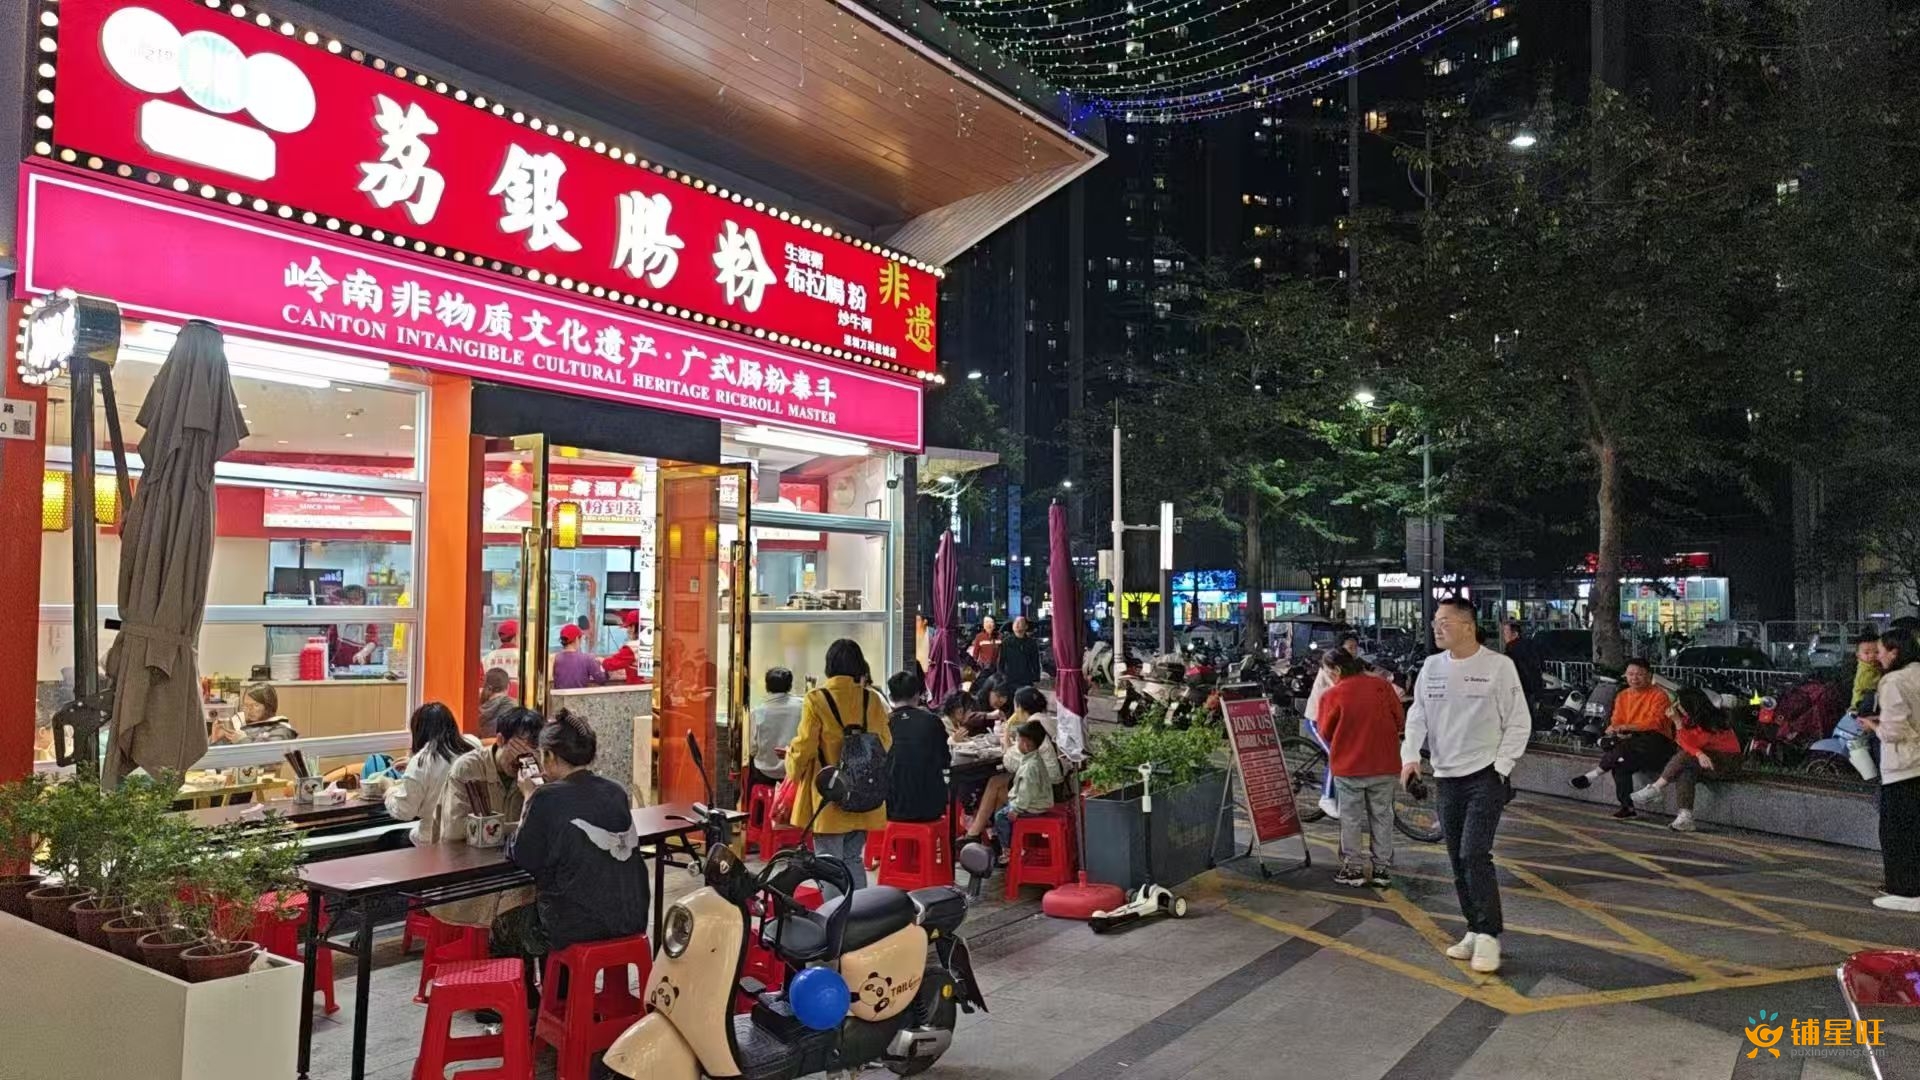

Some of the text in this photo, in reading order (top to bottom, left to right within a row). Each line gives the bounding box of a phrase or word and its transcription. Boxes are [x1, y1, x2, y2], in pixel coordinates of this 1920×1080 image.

[879, 259, 935, 352] 非遗
[282, 304, 837, 425] CANTON INTANGIBLE CULTURAL HERITAGE RICEROLL MASTER
[1231, 713, 1273, 733] JOIN US
